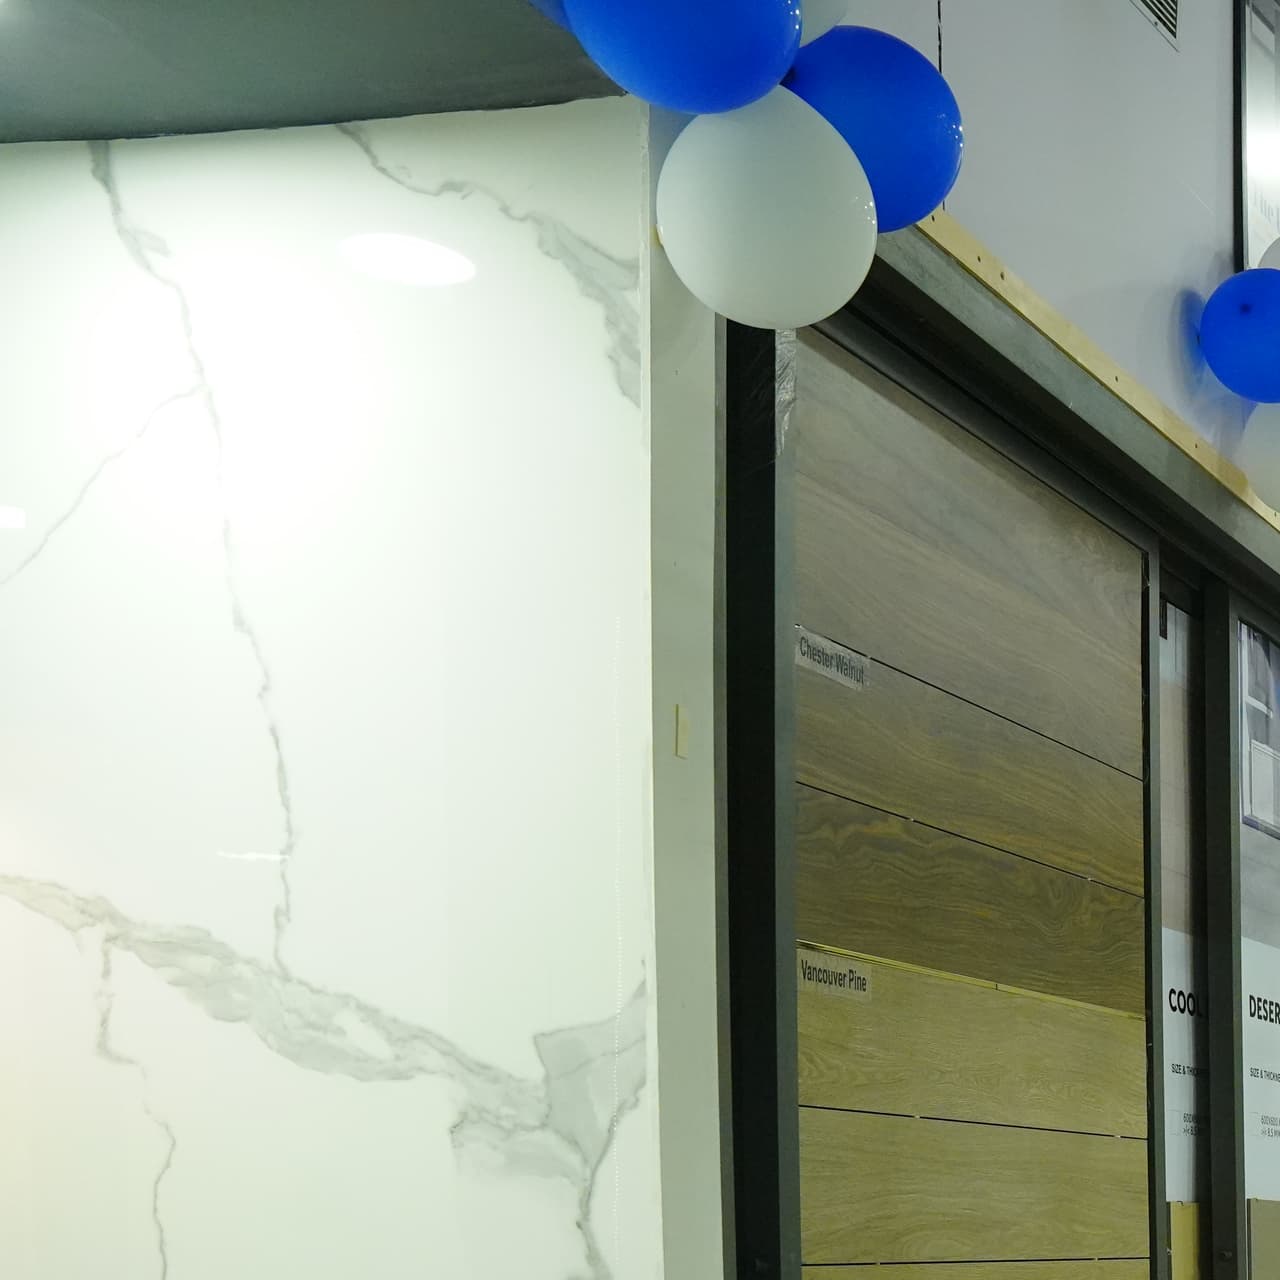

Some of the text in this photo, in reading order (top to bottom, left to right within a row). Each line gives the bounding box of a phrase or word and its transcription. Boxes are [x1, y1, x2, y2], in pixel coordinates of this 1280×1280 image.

[800, 636, 865, 685] Chester Walnut
[801, 959, 867, 992] Vancouver Pine
